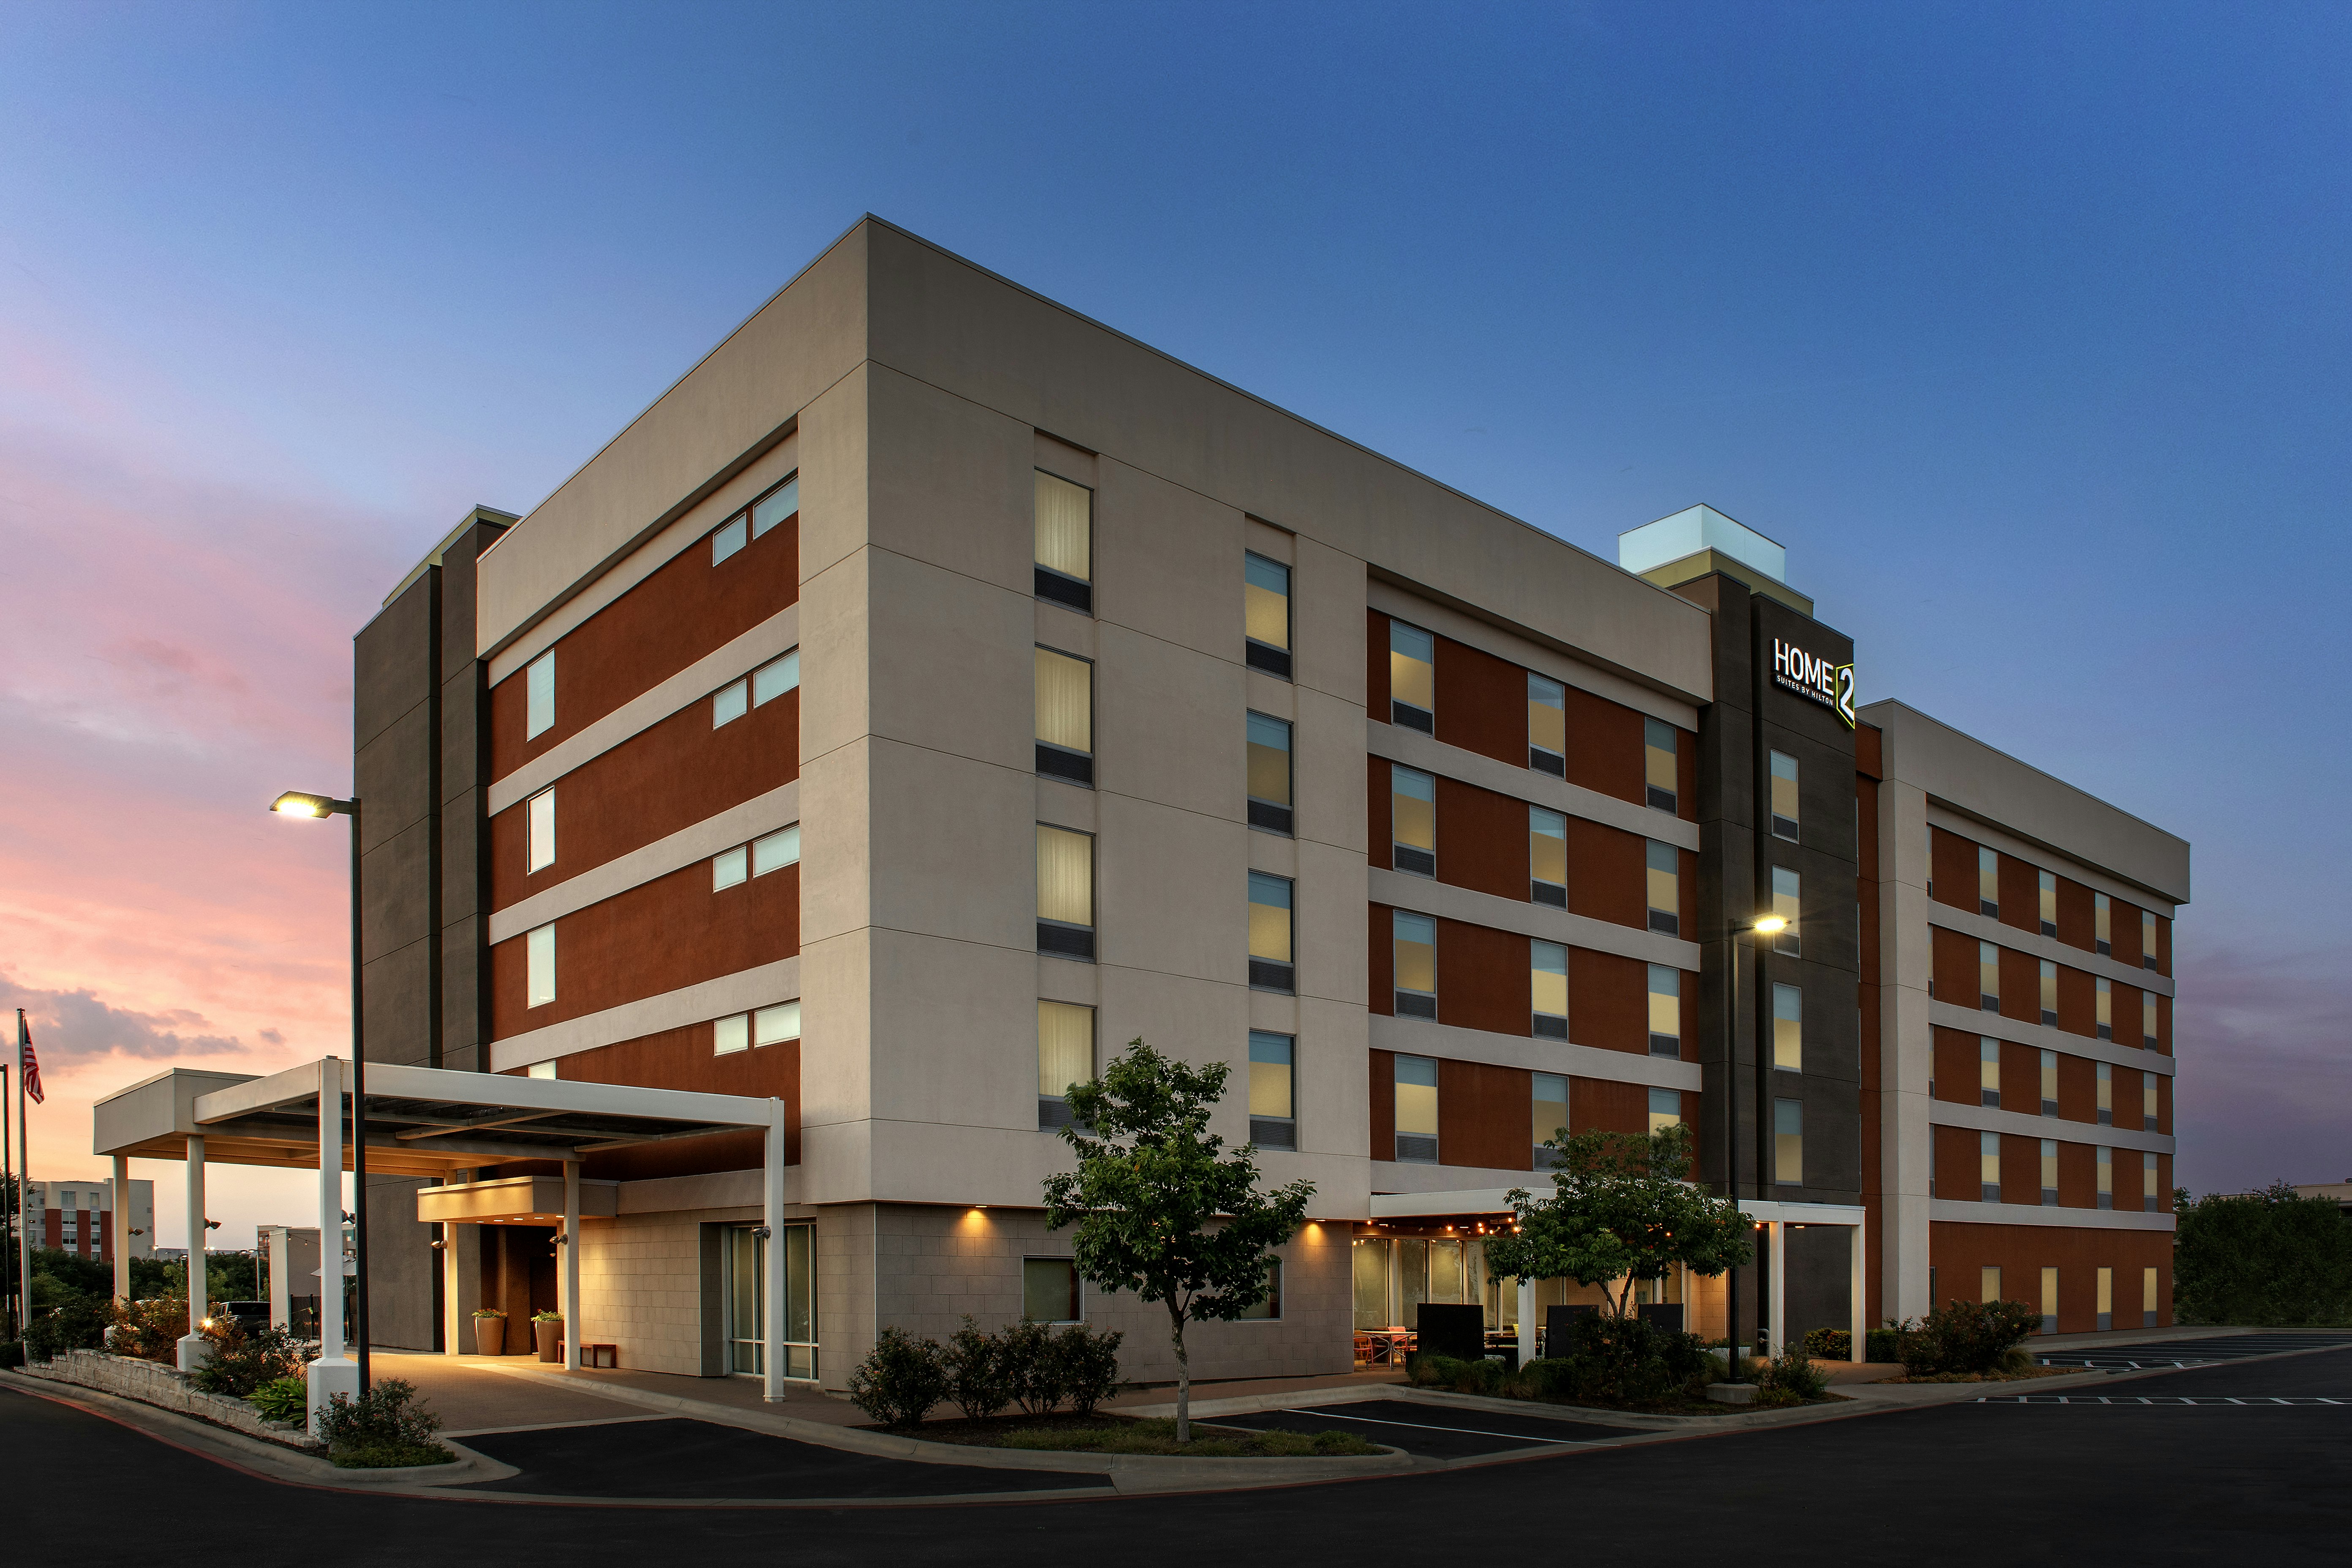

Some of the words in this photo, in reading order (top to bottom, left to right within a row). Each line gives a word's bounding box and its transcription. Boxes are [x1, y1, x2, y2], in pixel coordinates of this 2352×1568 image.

[1775, 638, 1834, 696] HOME
[1840, 668, 1855, 721] 2
[1777, 675, 1799, 691] SUITES
[1801, 686, 1810, 695] BY
[1811, 691, 1833, 706] HILTON
